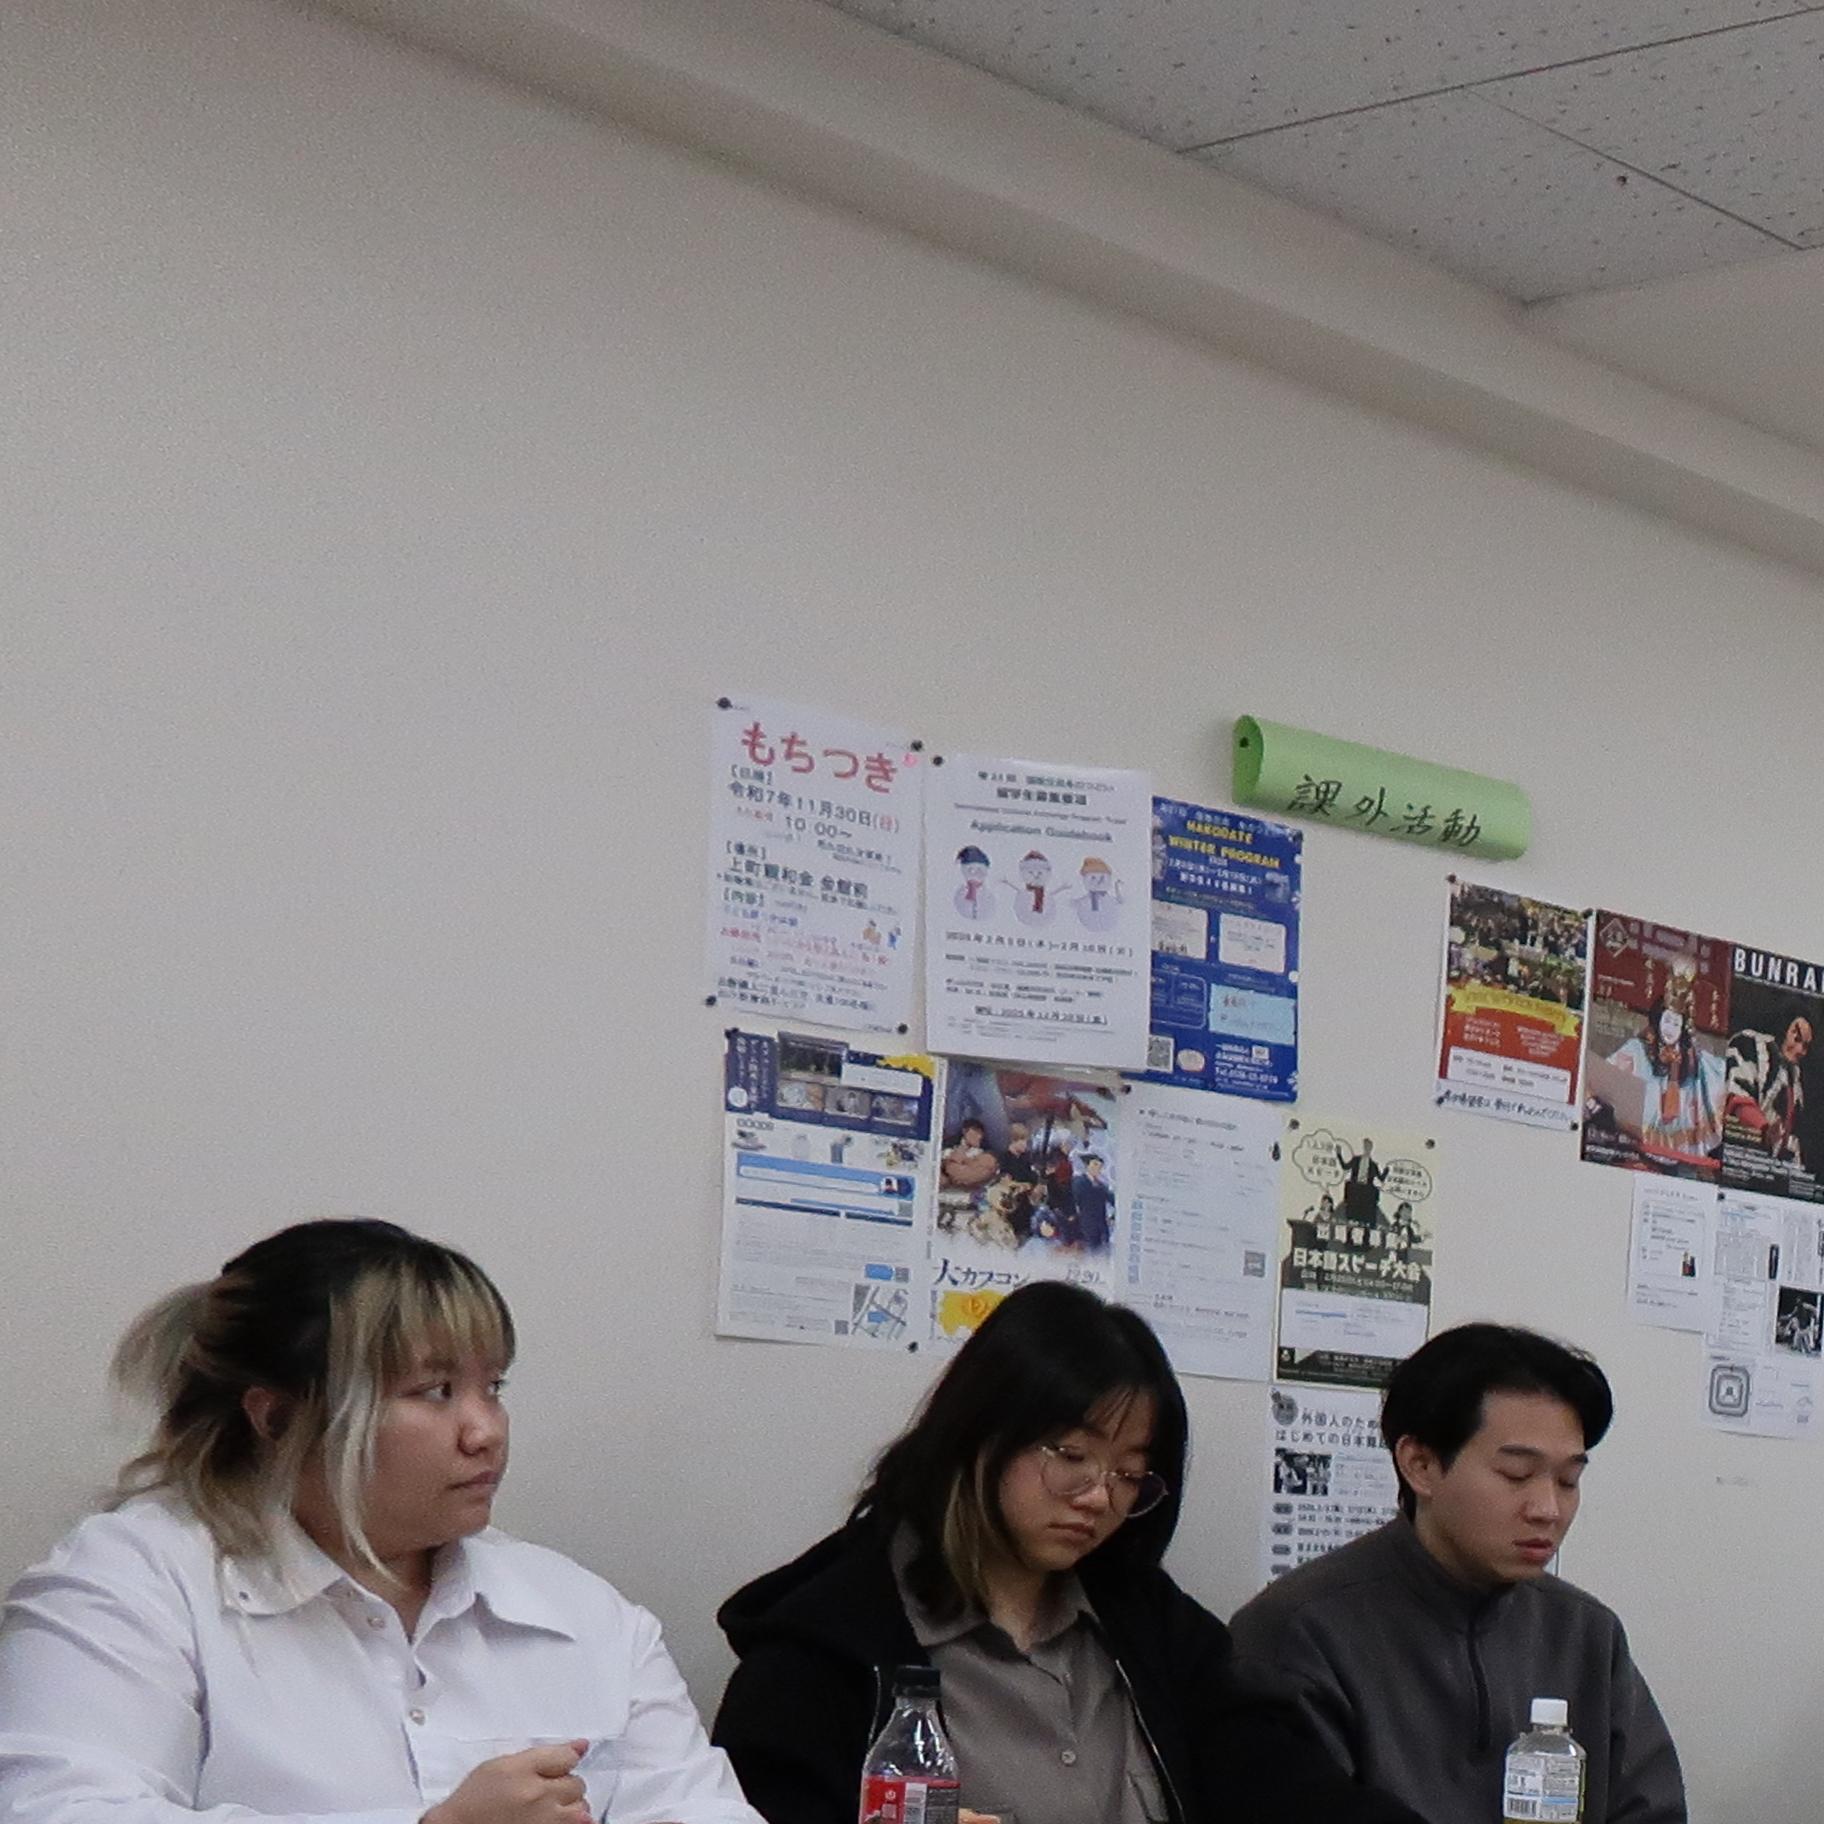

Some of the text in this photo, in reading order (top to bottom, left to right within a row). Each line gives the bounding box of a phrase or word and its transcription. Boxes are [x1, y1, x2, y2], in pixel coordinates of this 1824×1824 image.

[740, 720, 899, 794] もちつき
[1287, 773, 1482, 848] 課外活動
